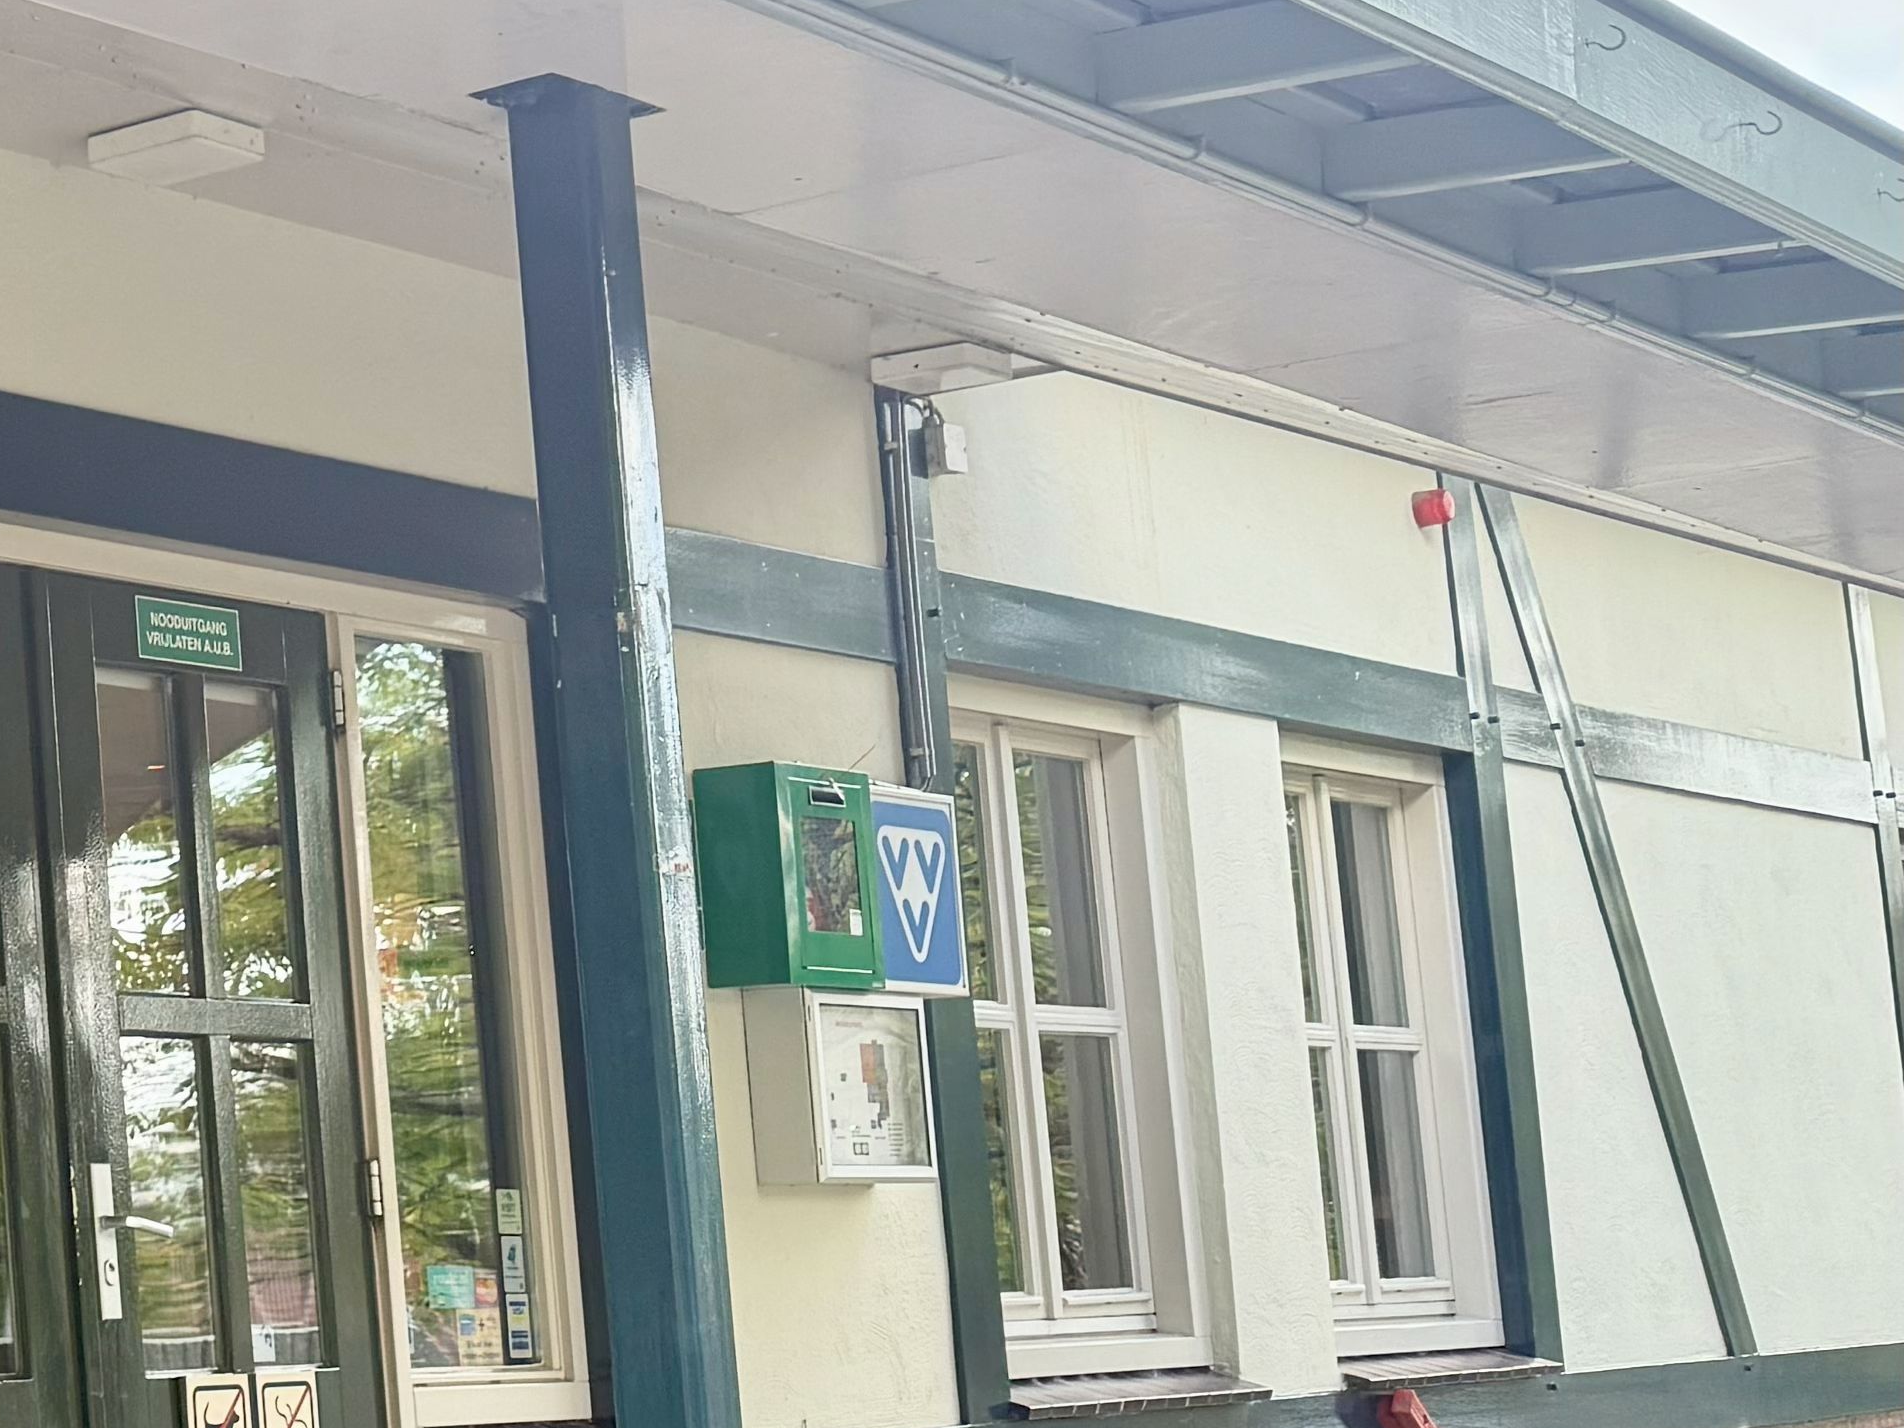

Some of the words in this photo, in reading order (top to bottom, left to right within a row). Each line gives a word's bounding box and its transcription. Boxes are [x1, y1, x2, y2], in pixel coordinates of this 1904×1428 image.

[150, 612, 227, 636] NOODUITGANG
[146, 631, 201, 652] VRIJLATEN
[203, 639, 234, 656] A.U.B.
